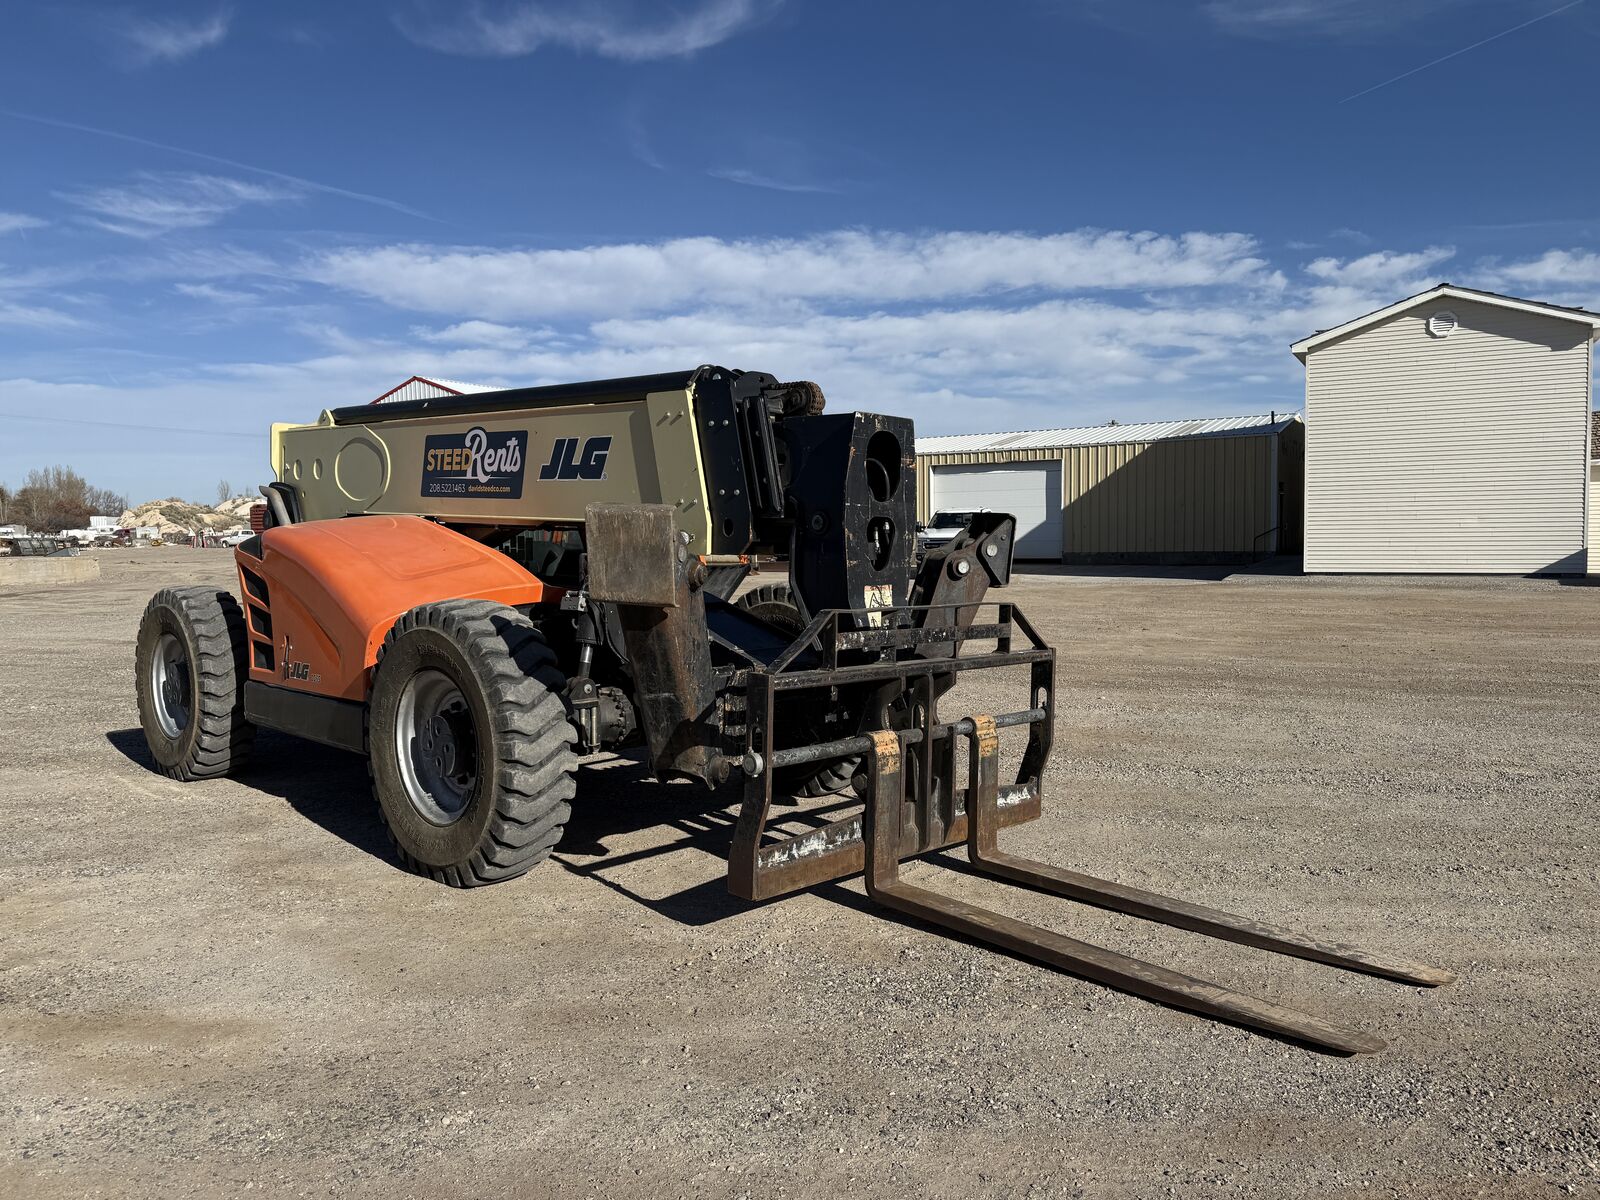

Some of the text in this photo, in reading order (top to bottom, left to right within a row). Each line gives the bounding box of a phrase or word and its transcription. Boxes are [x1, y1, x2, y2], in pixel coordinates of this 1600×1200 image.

[427, 429, 521, 484] STEED Rents
[538, 436, 613, 481] JLG
[468, 484, 511, 493] davidsteedco.com
[289, 661, 310, 680] JLG
